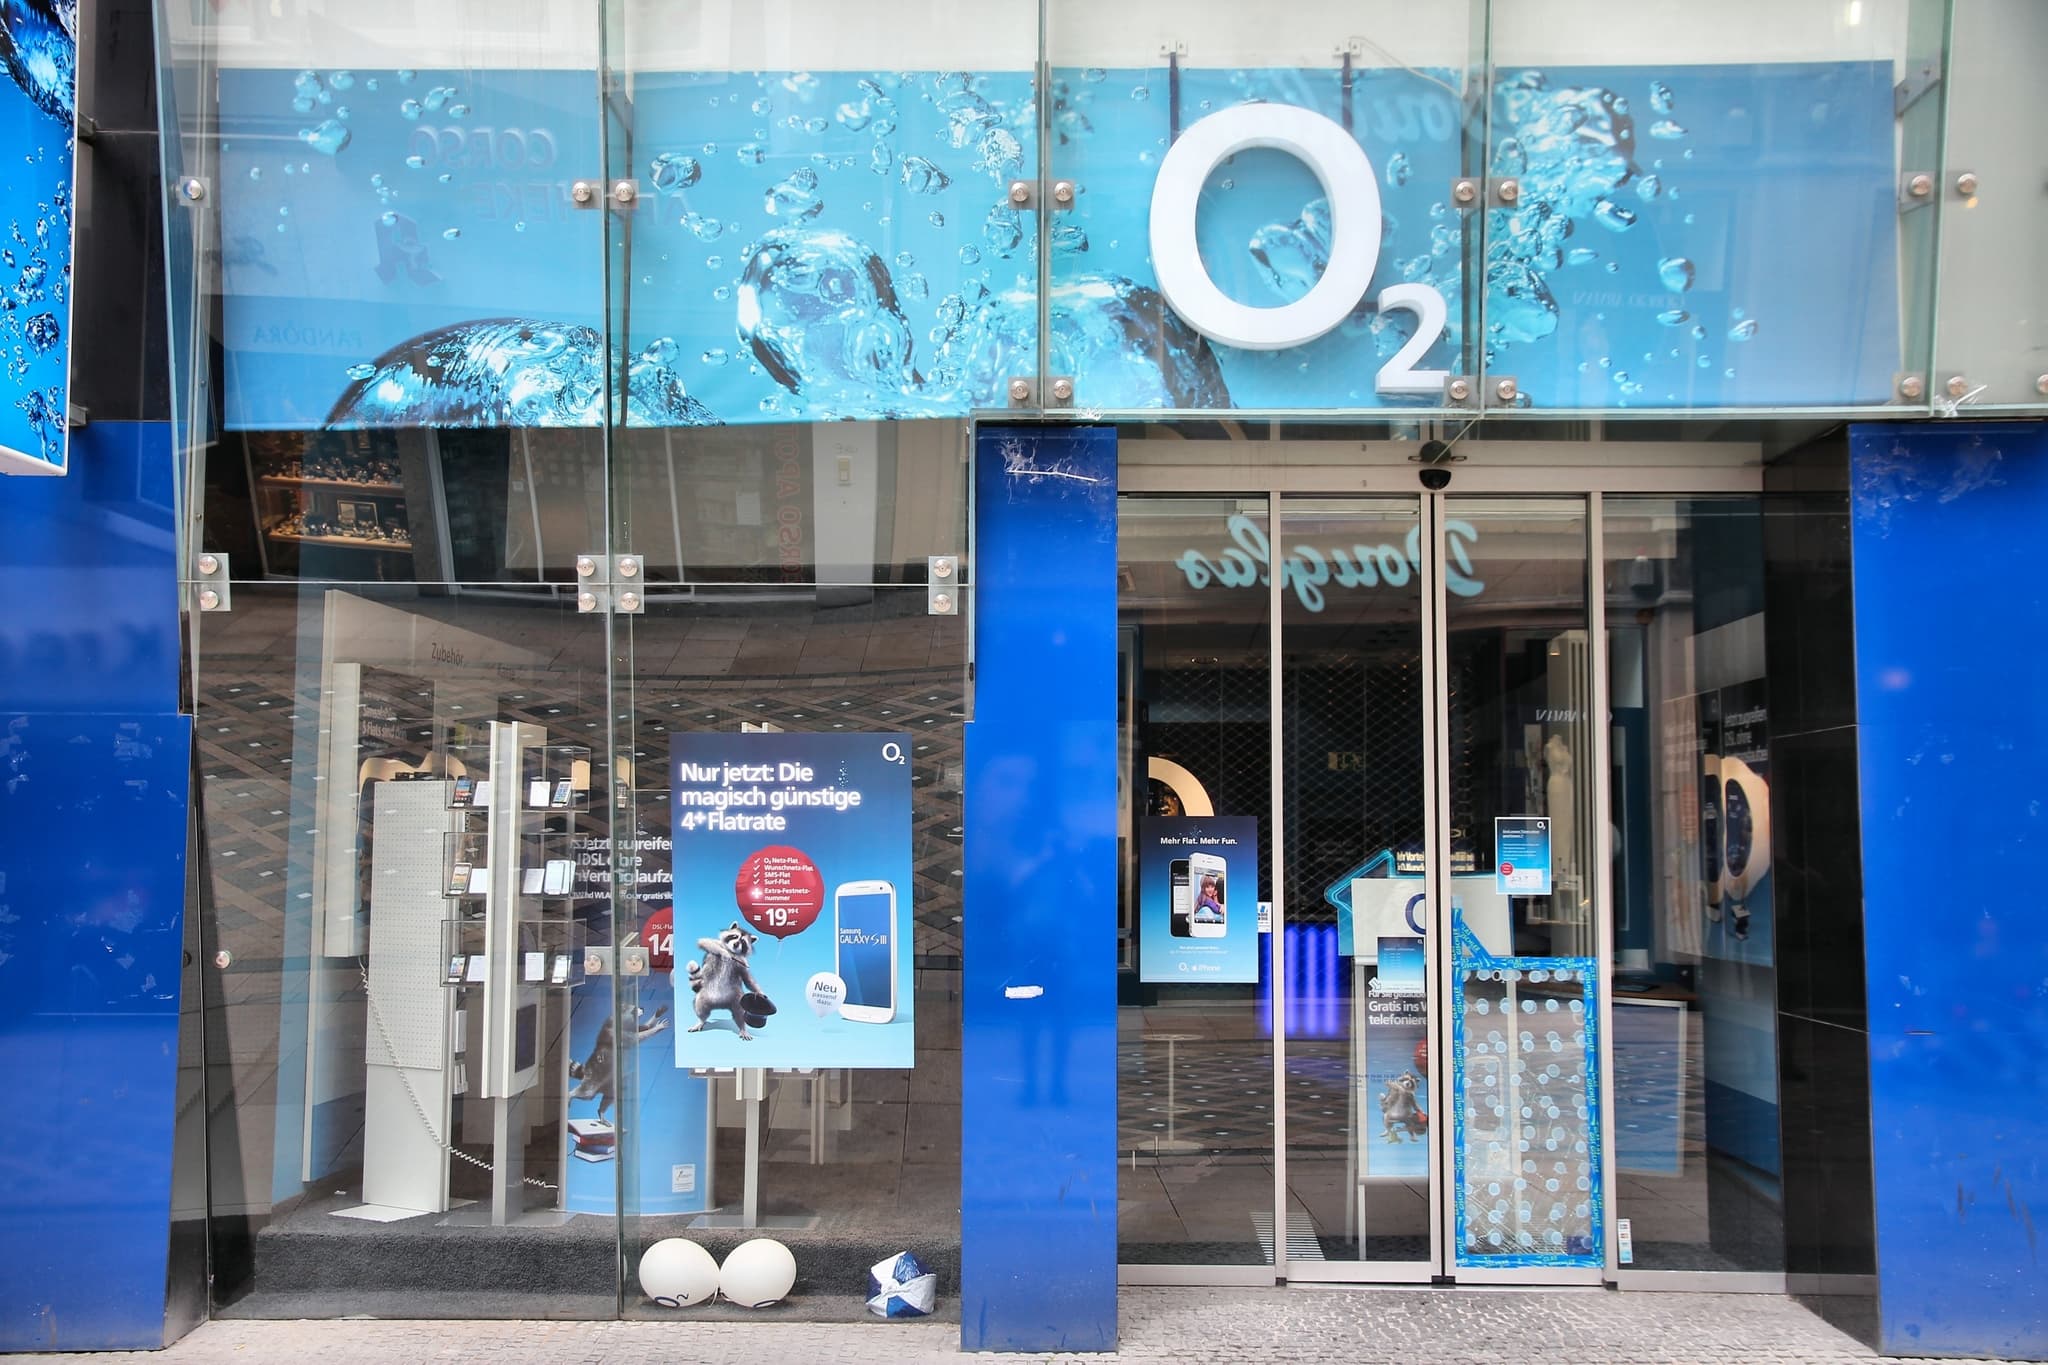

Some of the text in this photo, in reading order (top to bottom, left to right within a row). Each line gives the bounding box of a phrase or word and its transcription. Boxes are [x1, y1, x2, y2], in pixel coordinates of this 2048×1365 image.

[1150, 102, 1450, 394] O2
[882, 742, 905, 765] O2
[681, 761, 813, 787] Nur jetzt: Die
[681, 786, 861, 811] magisch günstige
[1160, 837, 1238, 845] Mehr Flat. Mehr Fun.
[766, 908, 787, 926] 19
[840, 935, 870, 945] GALAXY
[814, 981, 837, 993] Neu
[1368, 1000, 1401, 1012] Gratis
[1403, 1000, 1419, 1012] ins
